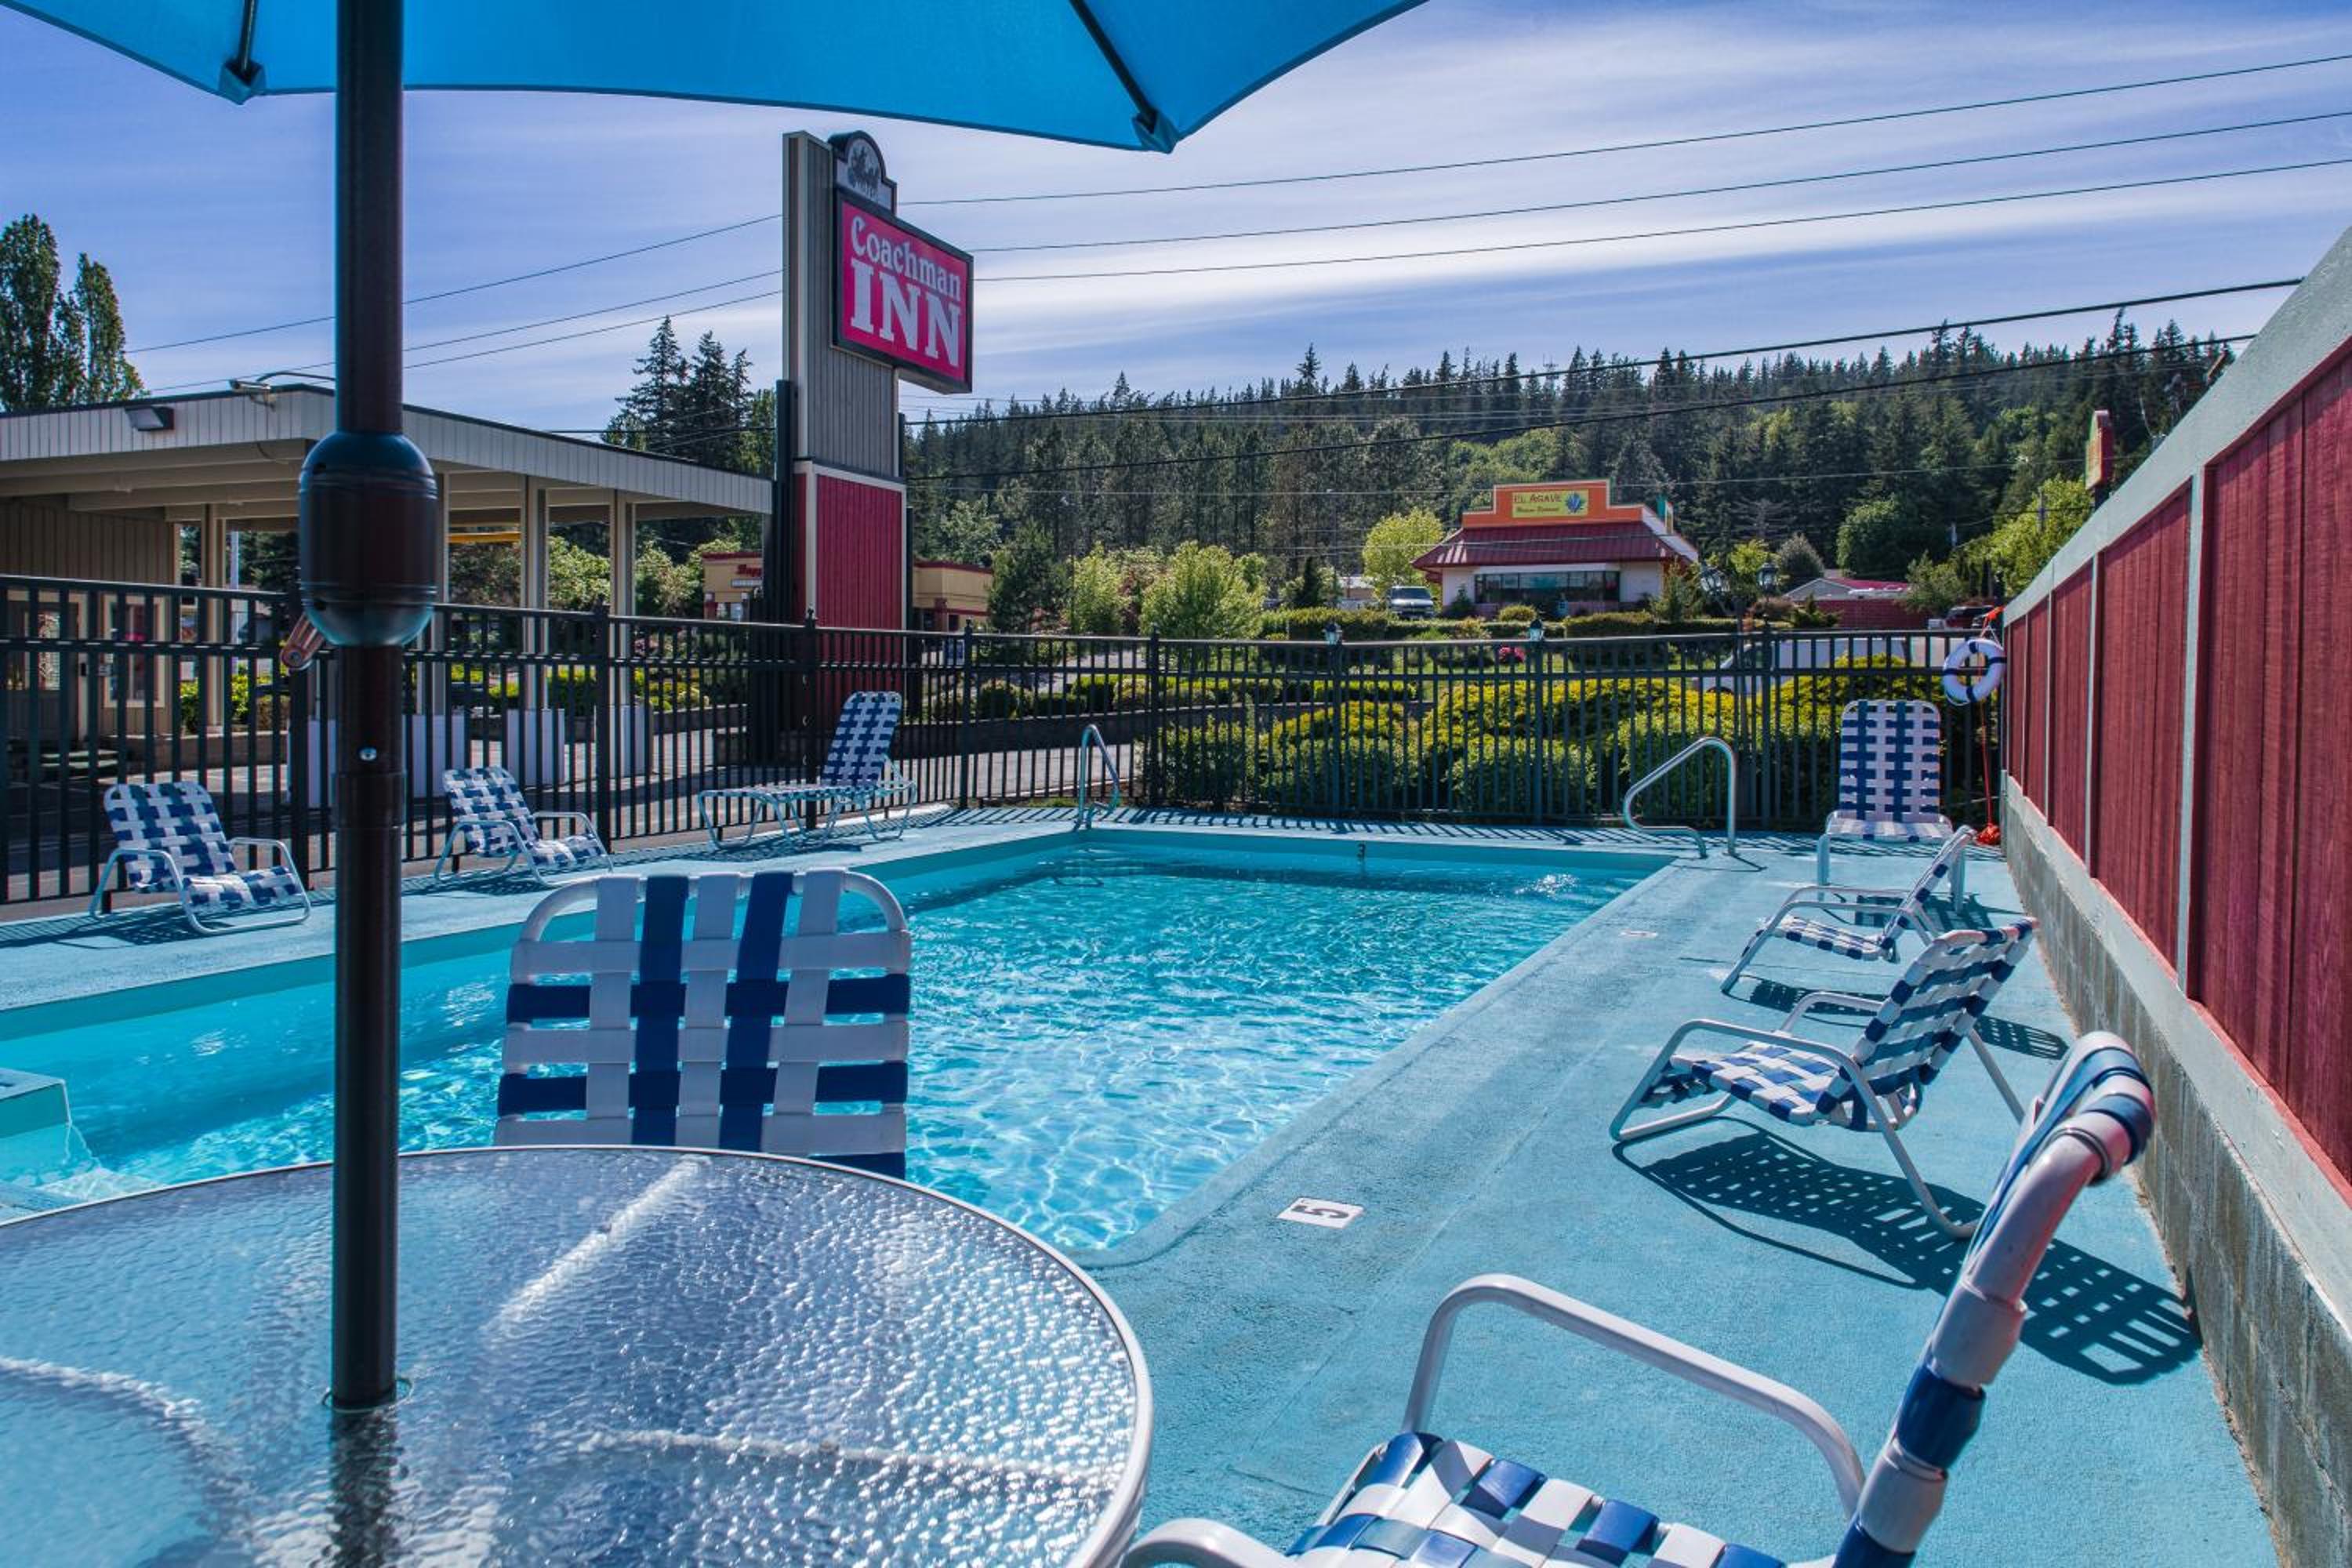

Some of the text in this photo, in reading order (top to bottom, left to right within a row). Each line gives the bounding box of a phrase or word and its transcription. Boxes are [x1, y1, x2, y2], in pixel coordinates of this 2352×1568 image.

[851, 216, 961, 302] Coachman
[851, 259, 962, 367] INN
[1357, 843, 1366, 861] 3
[1291, 1205, 1349, 1218] 5
